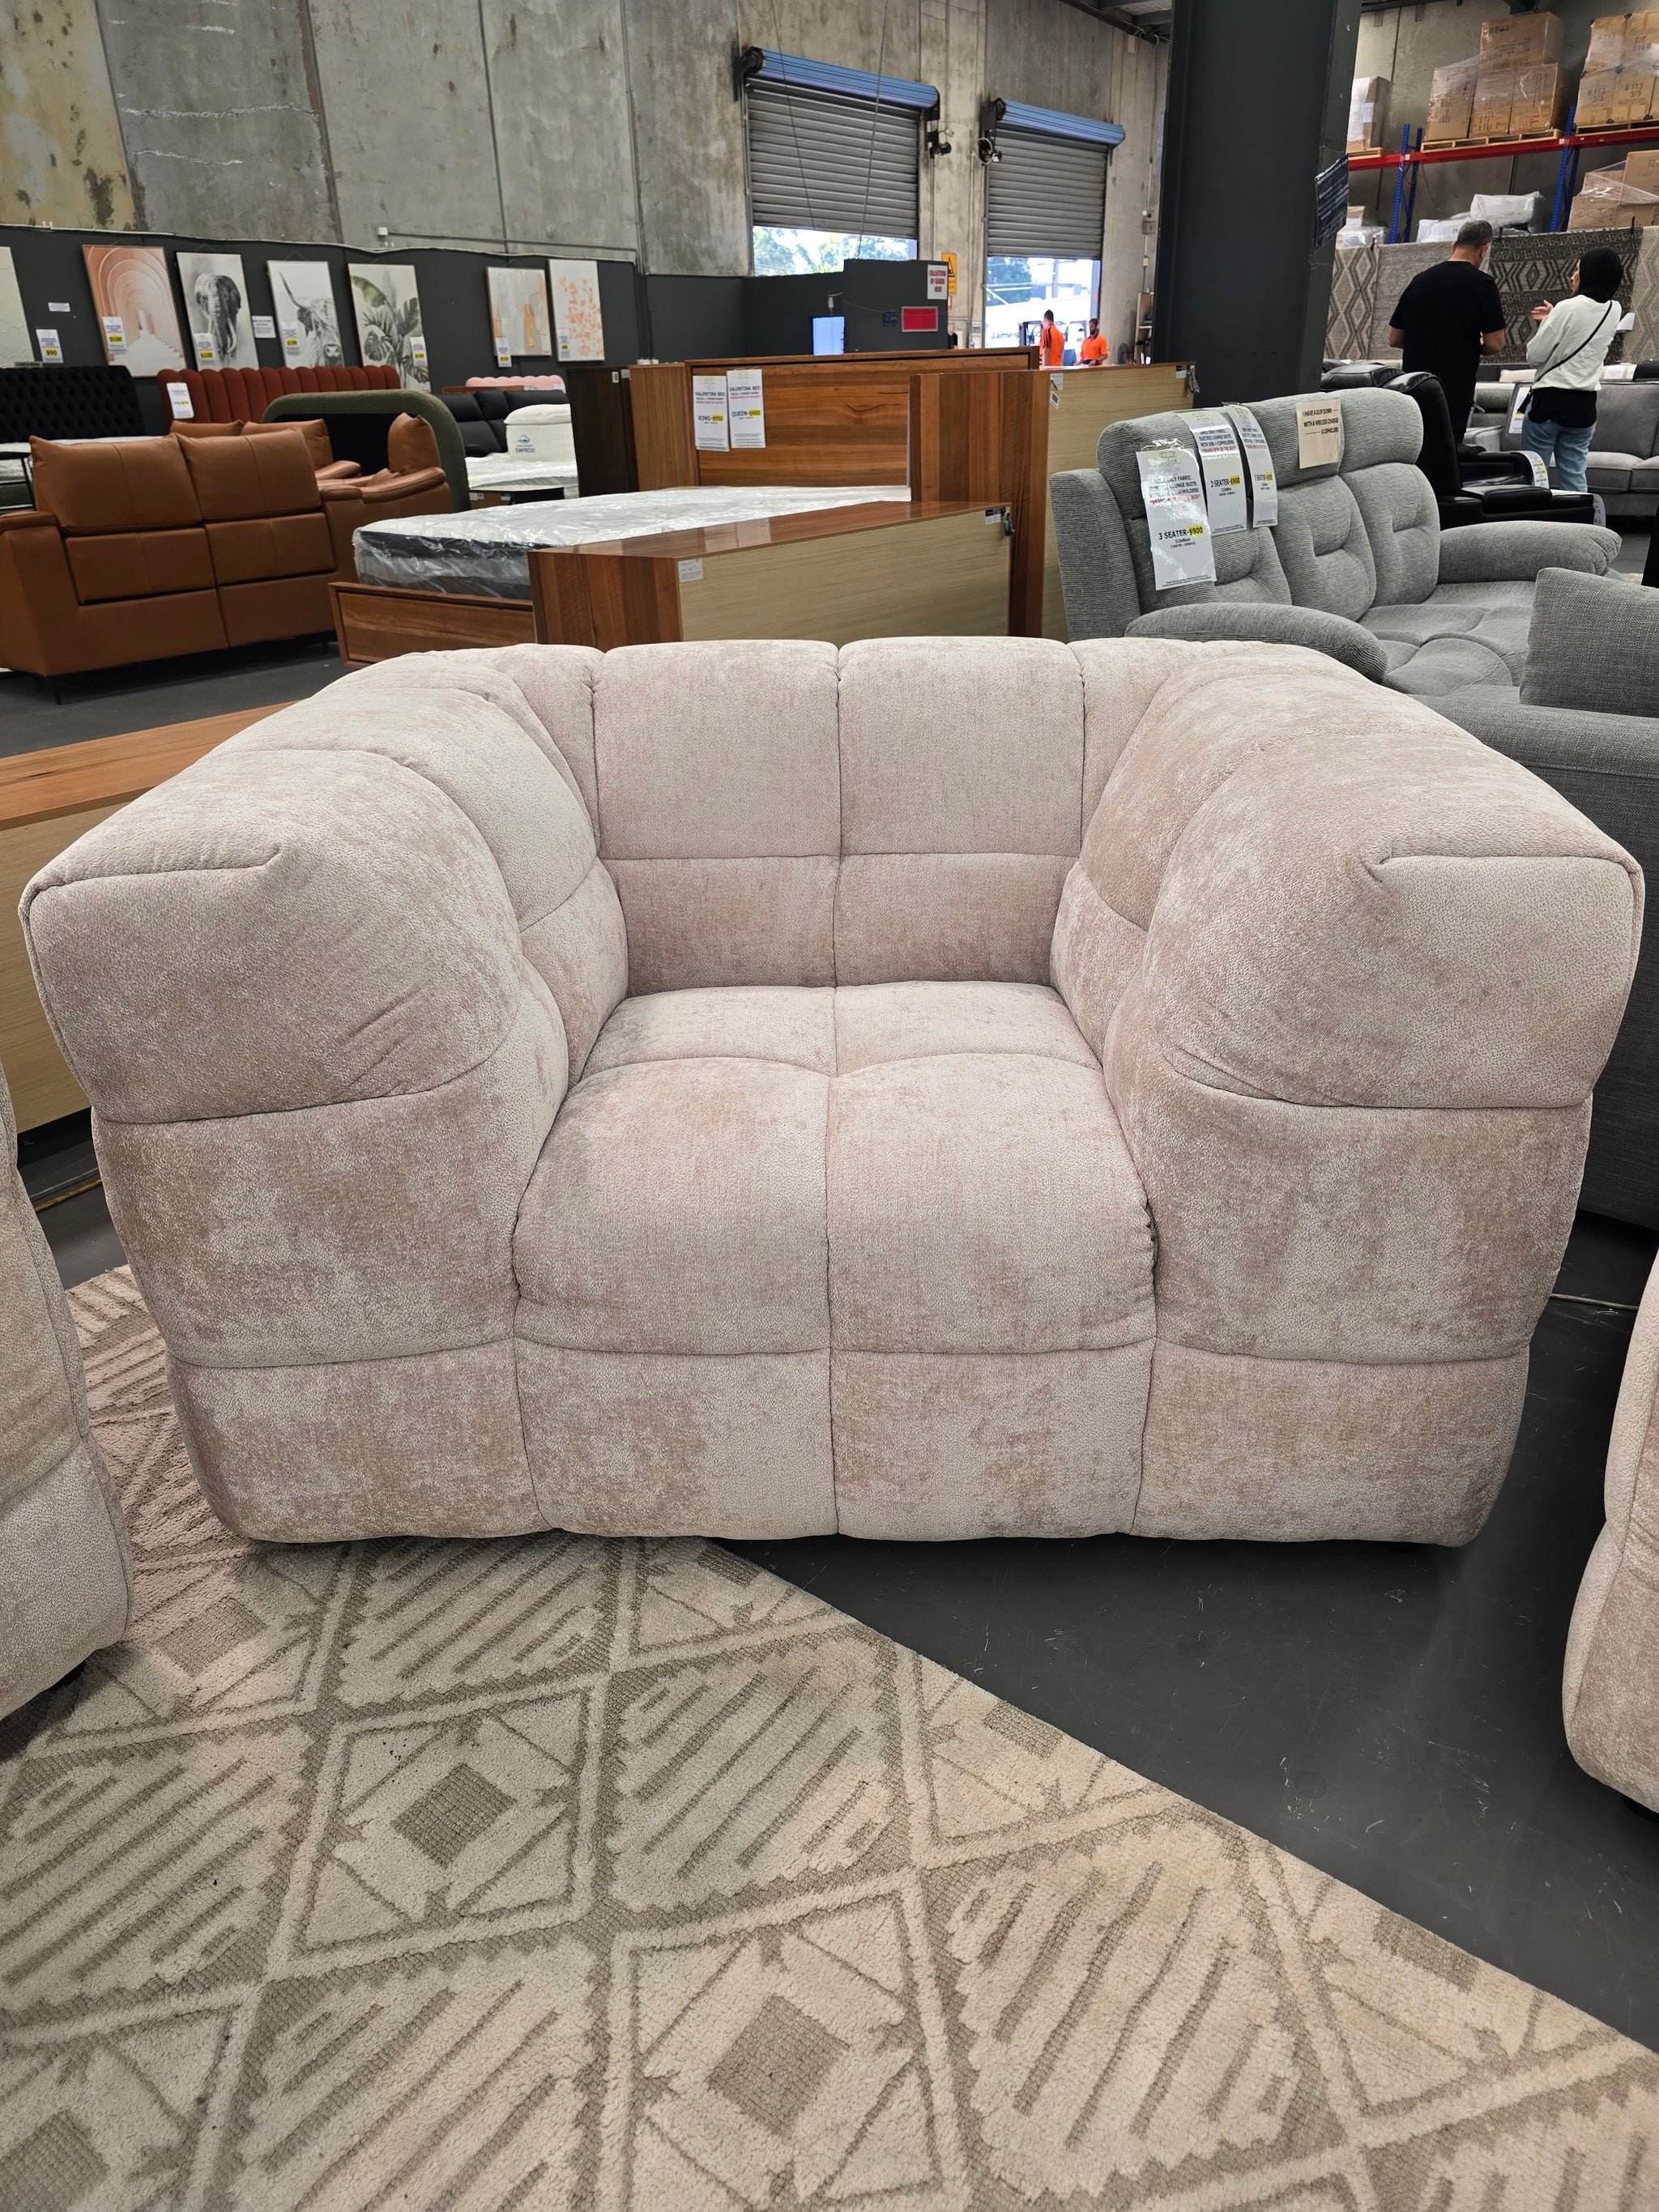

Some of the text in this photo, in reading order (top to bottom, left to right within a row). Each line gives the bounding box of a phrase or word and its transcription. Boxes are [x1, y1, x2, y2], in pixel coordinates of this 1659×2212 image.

[1625, 82, 1644, 91] #113
[1629, 90, 1642, 98] 3/3
[1158, 532, 1162, 540] 3
